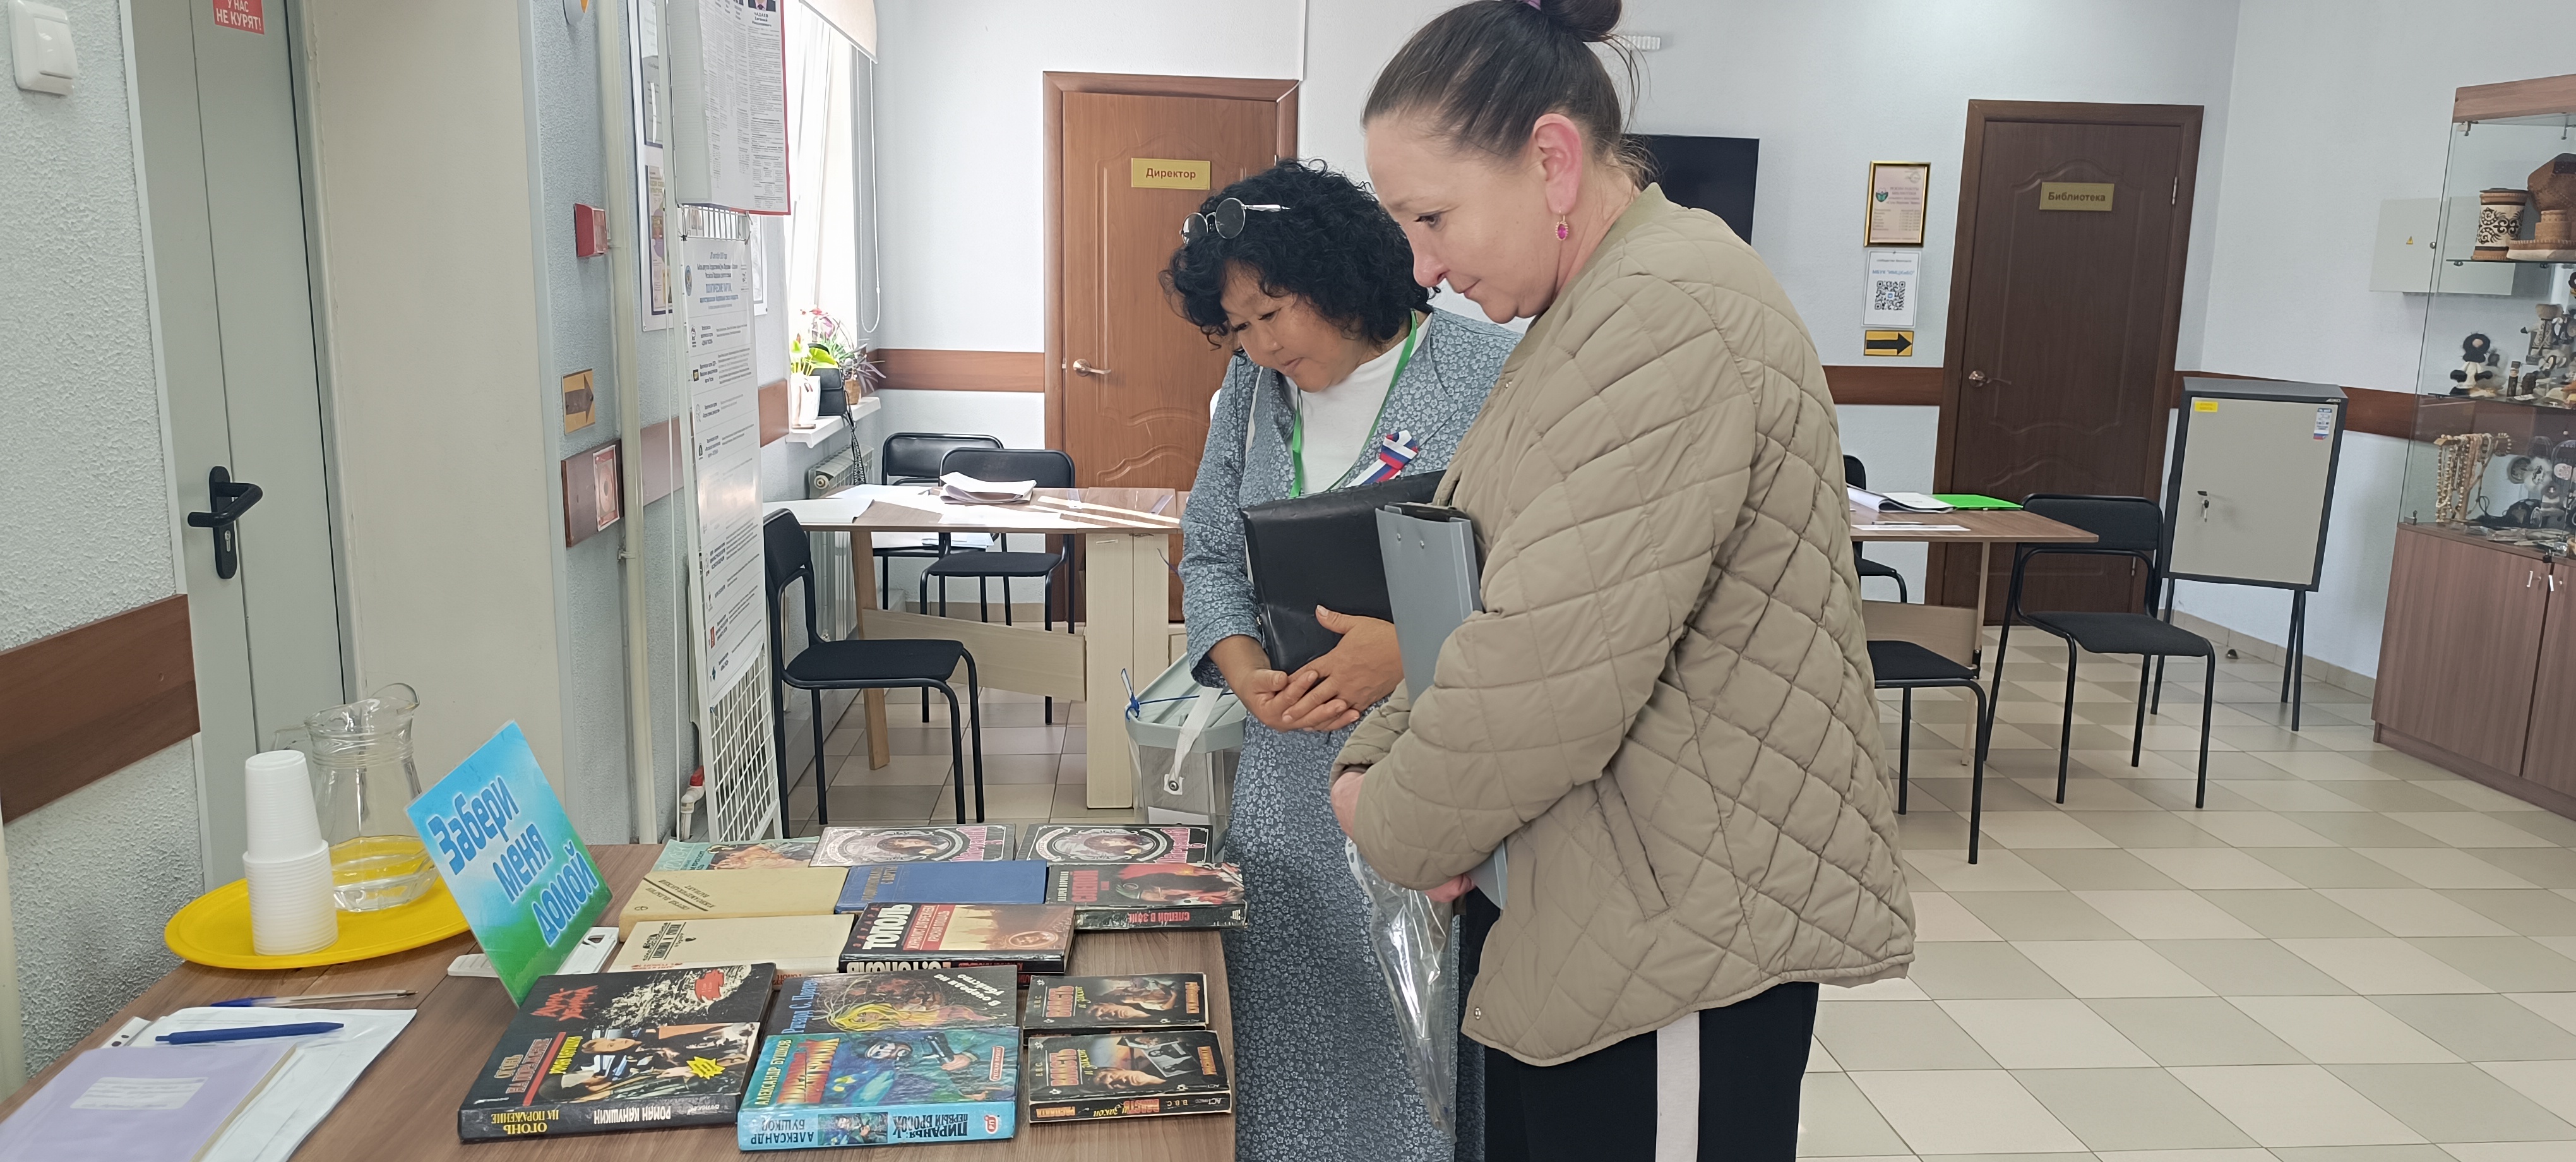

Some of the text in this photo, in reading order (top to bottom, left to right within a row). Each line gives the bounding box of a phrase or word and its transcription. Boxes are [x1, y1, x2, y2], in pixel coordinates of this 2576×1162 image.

[228, 0, 249, 13] У НАС
[216, 8, 262, 31] НЕ КУРЯТ!
[1146, 168, 1196, 180] Директор
[2048, 191, 2106, 201] Библиотека
[427, 777, 520, 875] Забери
[492, 824, 552, 902] меня
[532, 841, 599, 945] домой
[1068, 870, 1099, 902] СЛЕПОЙ
[1150, 913, 1156, 922] В
[1159, 911, 1190, 923] СЛЕПОЙ
[862, 904, 913, 950] ТОПОЛЬ
[933, 973, 950, 981] на
[948, 980, 991, 1001] очереди
[1076, 986, 1092, 1003] закон
[1046, 986, 1074, 1017] ВЛАСТЬ
[782, 1010, 813, 1033] Ричард
[806, 1038, 840, 1072] БРОСОК
[1078, 1050, 1097, 1070] закон
[494, 1055, 524, 1079] ОГОНЬ
[754, 1039, 792, 1105] АЛЕКСАНДР БУШКОВ
[1051, 1048, 1079, 1086] ВЛАСТЬ
[593, 1106, 640, 1124] КАНУШКИН
[641, 1105, 671, 1121] РОМАН
[1094, 1105, 1118, 1117] закон
[1123, 1098, 1159, 1113] ВЛАСТЬ
[491, 1109, 559, 1123] НА ПОРАЖЕНИЕ
[891, 1113, 967, 1138] ПЕРВЫЙ БРОСОК
[503, 1121, 547, 1135] ОГОНЬ
[749, 1131, 814, 1144] АЛЕКСАНДР
[904, 1122, 967, 1139] ПИРАНЬЯ:
